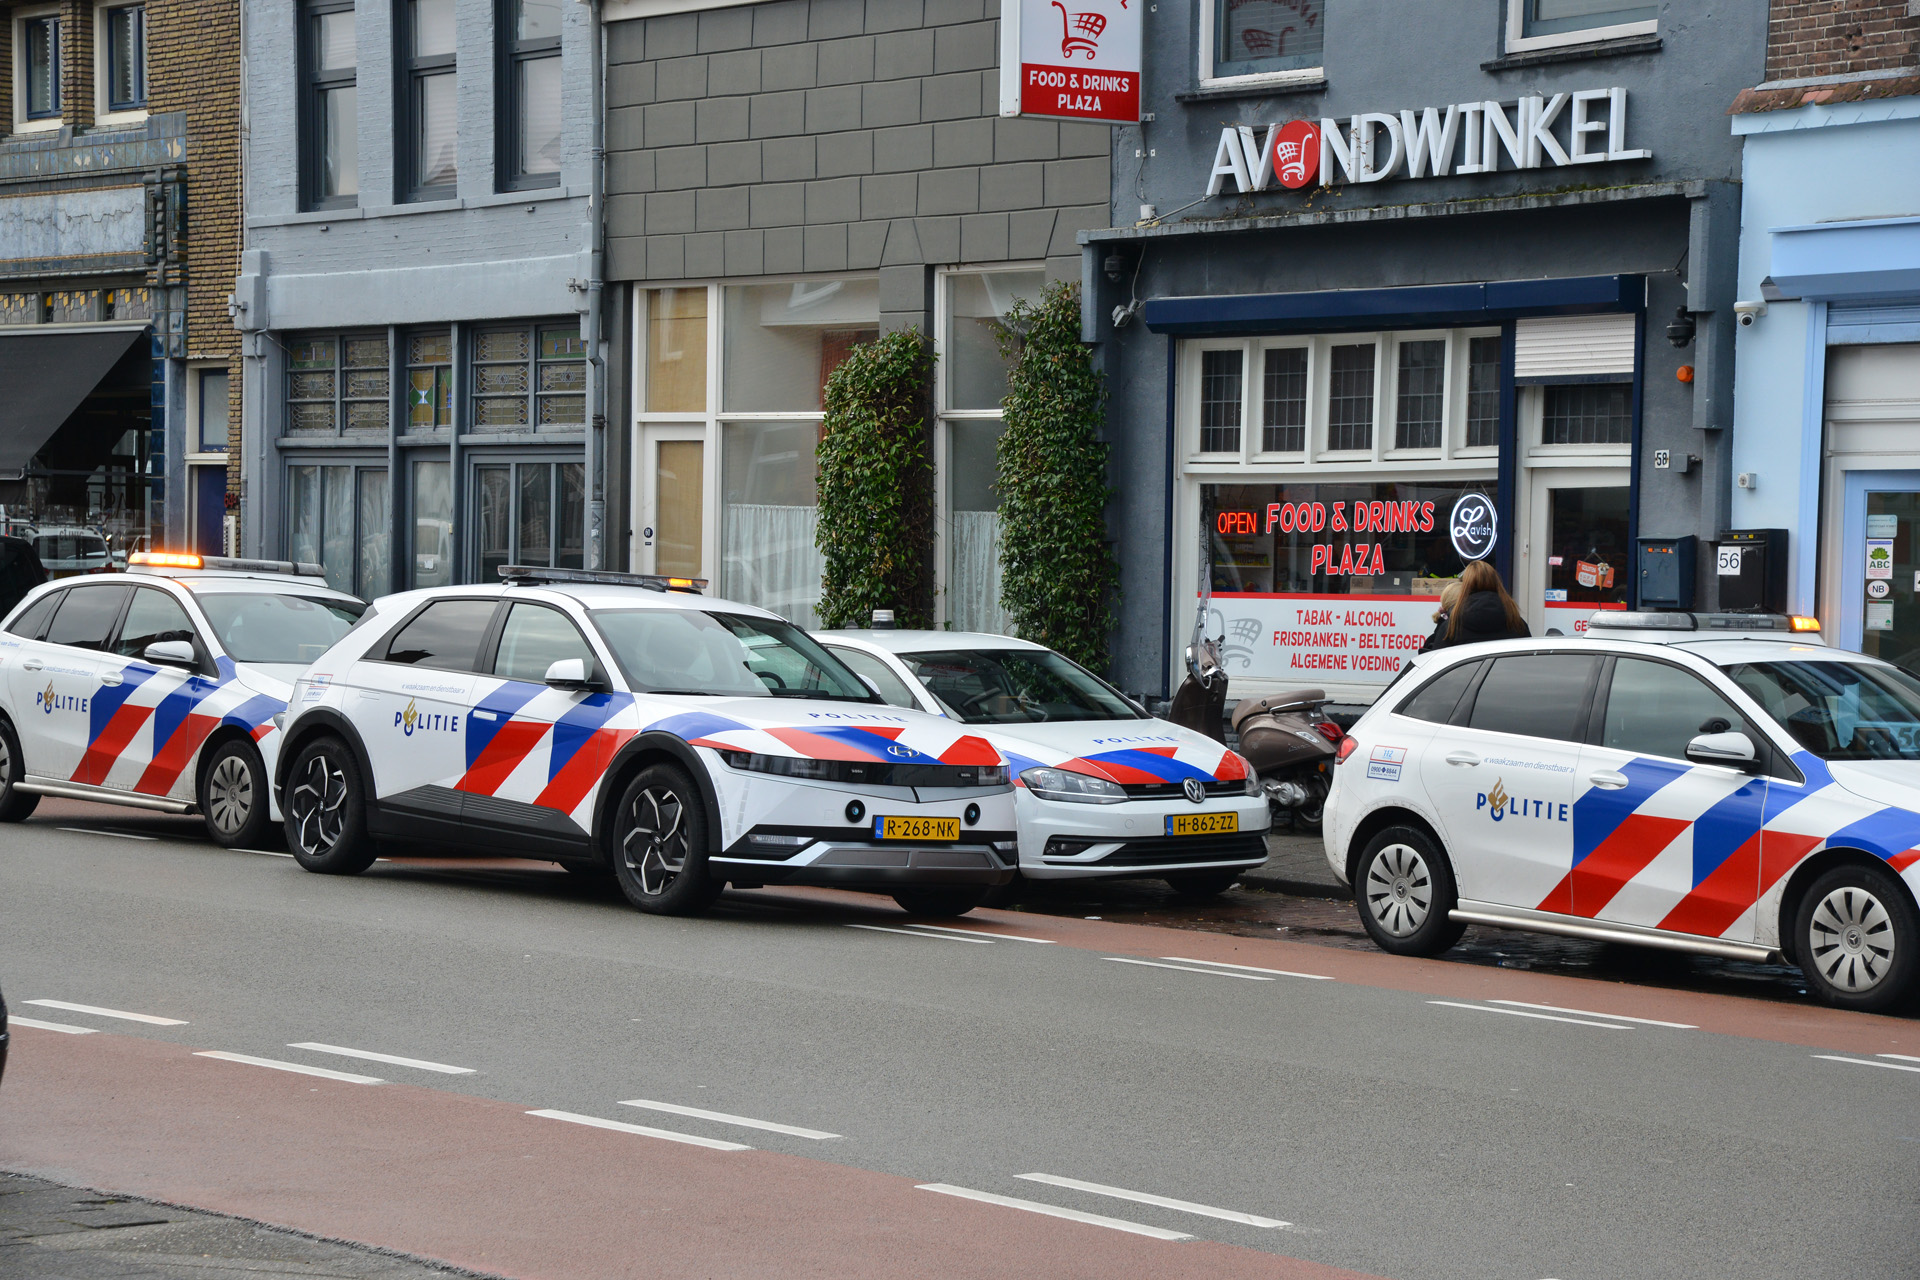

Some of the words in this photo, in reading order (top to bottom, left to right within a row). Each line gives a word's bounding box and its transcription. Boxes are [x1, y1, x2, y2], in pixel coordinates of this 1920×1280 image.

[1029, 70, 1067, 87] FOOD
[1070, 73, 1080, 88] &
[1082, 74, 1130, 93] DRINKS
[1057, 93, 1102, 112] PLAZA
[1656, 452, 1668, 466] 58
[1218, 512, 1257, 533] OPEN
[1265, 502, 1327, 533] FOOD
[1331, 501, 1349, 533] &
[1354, 500, 1436, 533] DRINKS
[1454, 505, 1492, 545] Lavish
[1310, 543, 1386, 576] PLAZA
[1718, 552, 1740, 569] 56
[1869, 560, 1890, 569] ABC
[1872, 585, 1885, 593] NB
[1296, 609, 1333, 626] TABAK
[1343, 610, 1396, 627] ALCOHOL
[1574, 620, 1591, 632] GE
[1273, 630, 1348, 648] FRISDRANKEN
[1358, 633, 1426, 650] BELTEGOED
[1290, 653, 1348, 670] ALGEMENE
[1351, 656, 1400, 672] VOEDING
[36, 691, 88, 714] POLITIE
[394, 711, 459, 737] POLITIE
[808, 712, 909, 722] POLITIE
[1092, 736, 1179, 745] POLITIE
[1383, 749, 1394, 758] 112
[1489, 757, 1524, 767] waakzaam
[1524, 761, 1533, 769] en
[1533, 761, 1570, 773] dienstbaar
[1476, 792, 1569, 822] POLITIE
[887, 819, 955, 837] R-268-NK
[1178, 815, 1234, 832] H-862-ZZ
